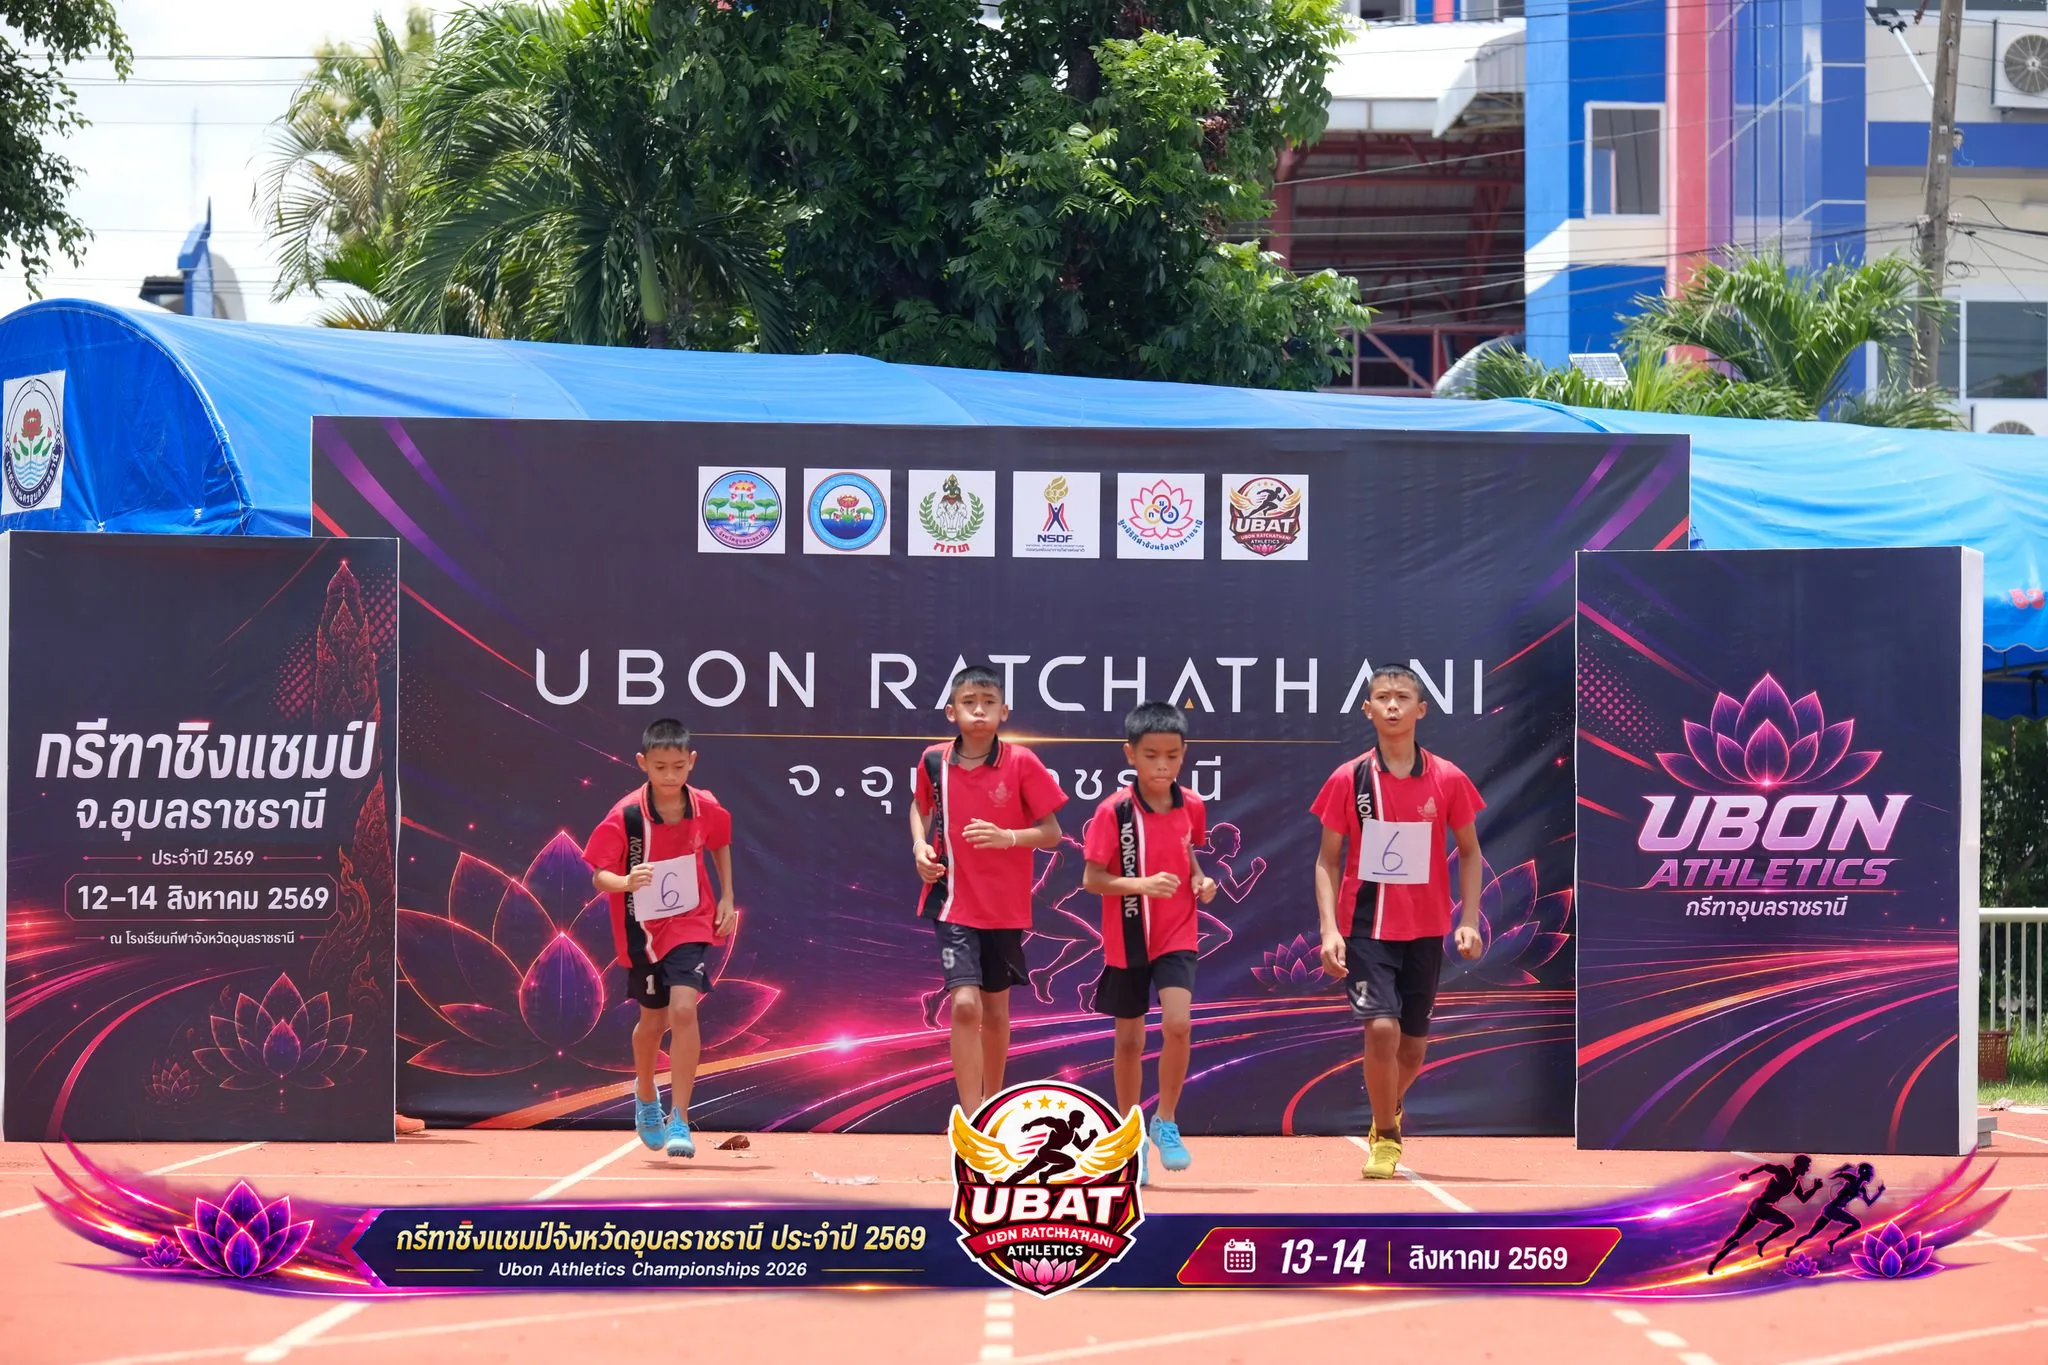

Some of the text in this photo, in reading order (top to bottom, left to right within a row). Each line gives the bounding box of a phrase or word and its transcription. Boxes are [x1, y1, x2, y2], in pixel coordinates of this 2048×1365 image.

[1037, 534, 1073, 543] NSDF
[1235, 518, 1296, 533] UBAT
[535, 648, 816, 708] UBON
[35, 717, 377, 779] กรีฑาชิงแชมป์
[76, 787, 327, 842] จ.อุบลราชธานี
[1638, 795, 1913, 851] UBON
[151, 849, 254, 866] ประจำปี 2569
[1382, 831, 1404, 873] 6
[1634, 858, 1904, 889] ATHLETICS
[166, 884, 259, 910] สิงหาคม
[268, 887, 329, 910] 2569
[660, 872, 680, 908] 6
[1685, 895, 1849, 922] กรีฑาอุบลราชธานี
[110, 930, 295, 948] ณ โรงเรียนกีฬาจังหวัดอุบลราชธานี
[646, 974, 656, 995] 1
